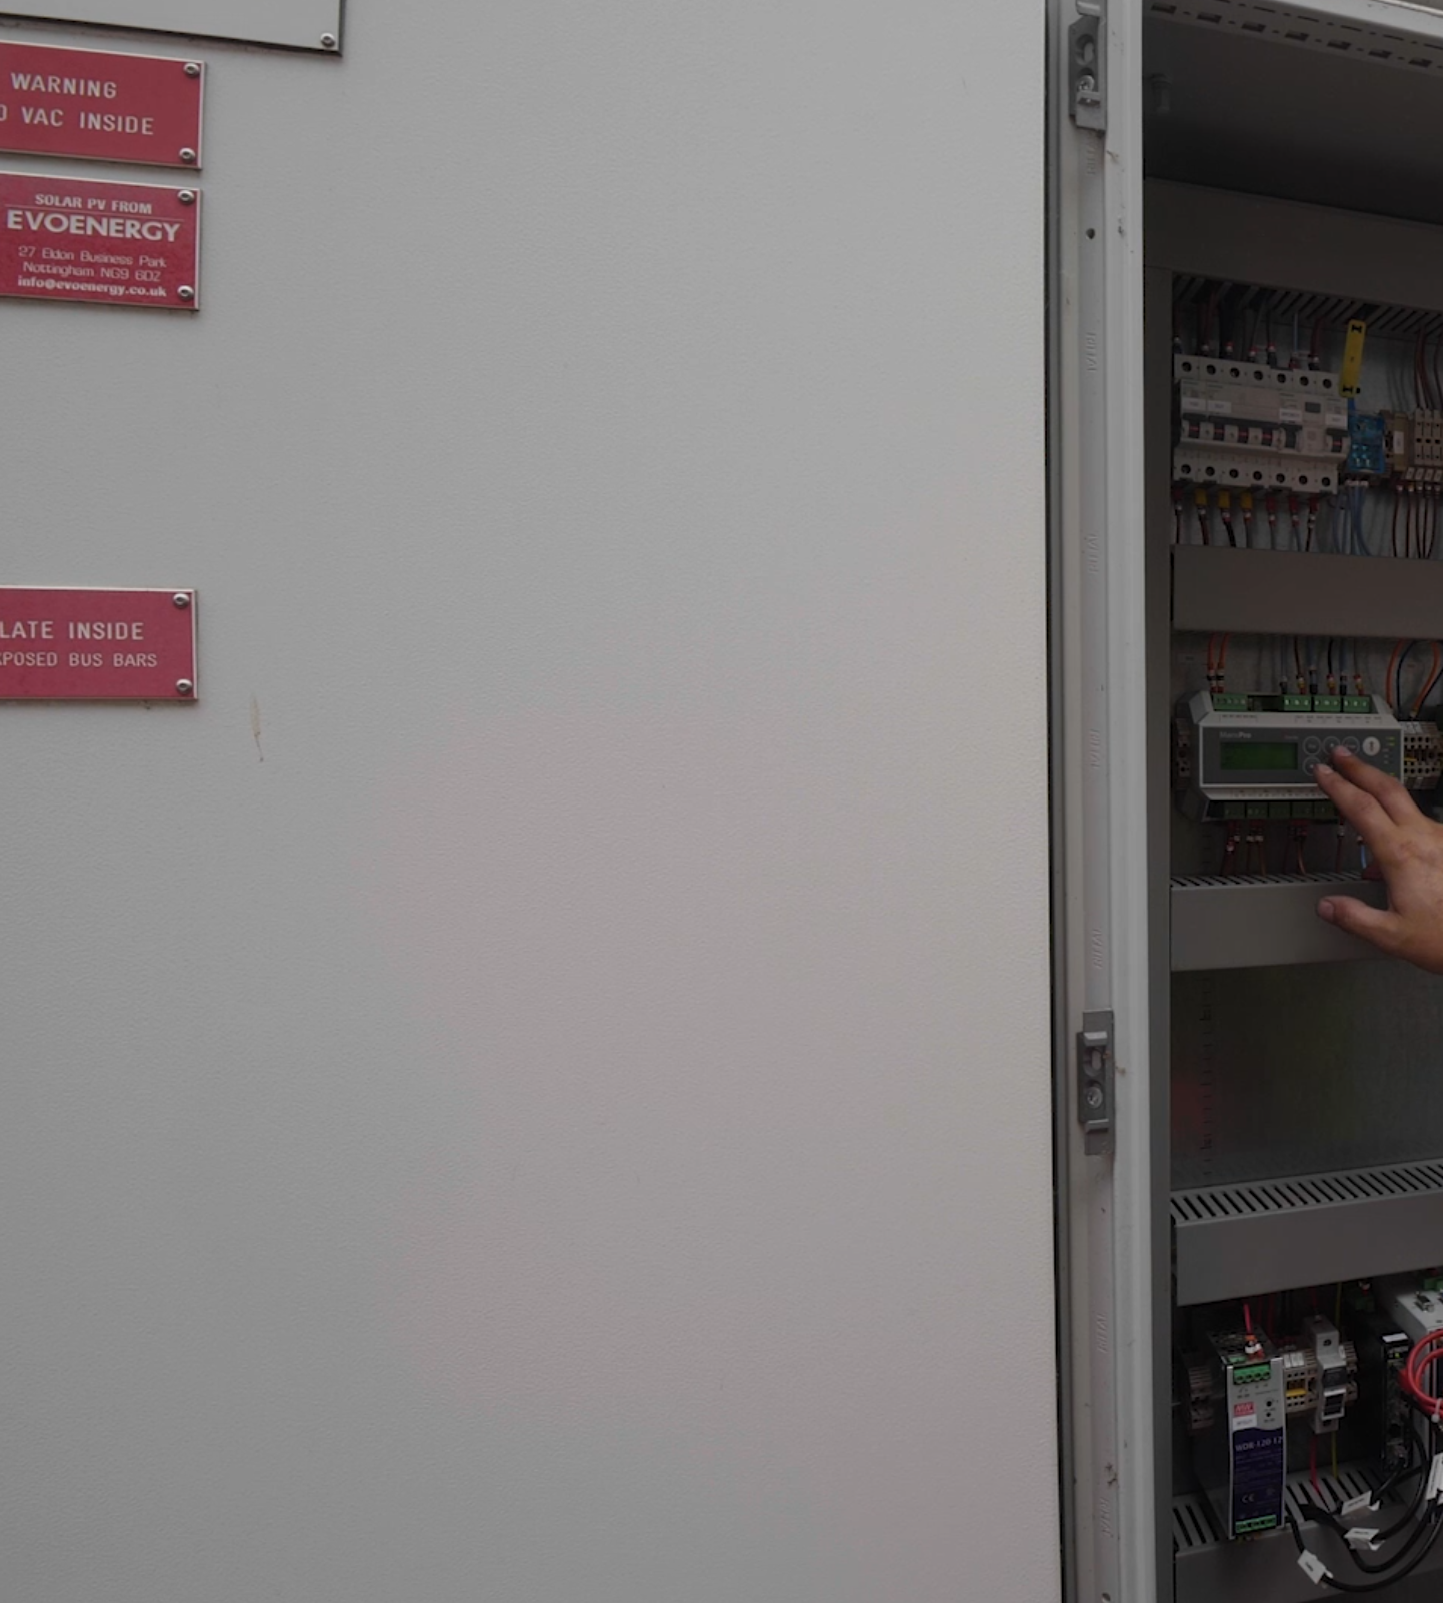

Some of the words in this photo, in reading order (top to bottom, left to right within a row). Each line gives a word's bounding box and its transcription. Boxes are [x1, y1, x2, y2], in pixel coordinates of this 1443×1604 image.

[10, 72, 117, 99] WARNING
[21, 106, 64, 127] VAC
[79, 111, 154, 135] INSIDE
[35, 194, 82, 208] SOLAR
[87, 198, 106, 211] PV
[111, 201, 152, 214] FROM
[7, 209, 181, 242] EVOENERGY
[18, 246, 36, 258] 27
[42, 248, 74, 261] Eldon
[80, 250, 133, 265] Business
[139, 255, 167, 268] Park
[23, 261, 94, 277] Nottingham
[100, 268, 129, 280] NG9
[18, 275, 167, 297] info@evoenergy.co.uk
[69, 622, 144, 640] INSIDE
[69, 652, 103, 667] BUS
[113, 652, 158, 667] BARS
